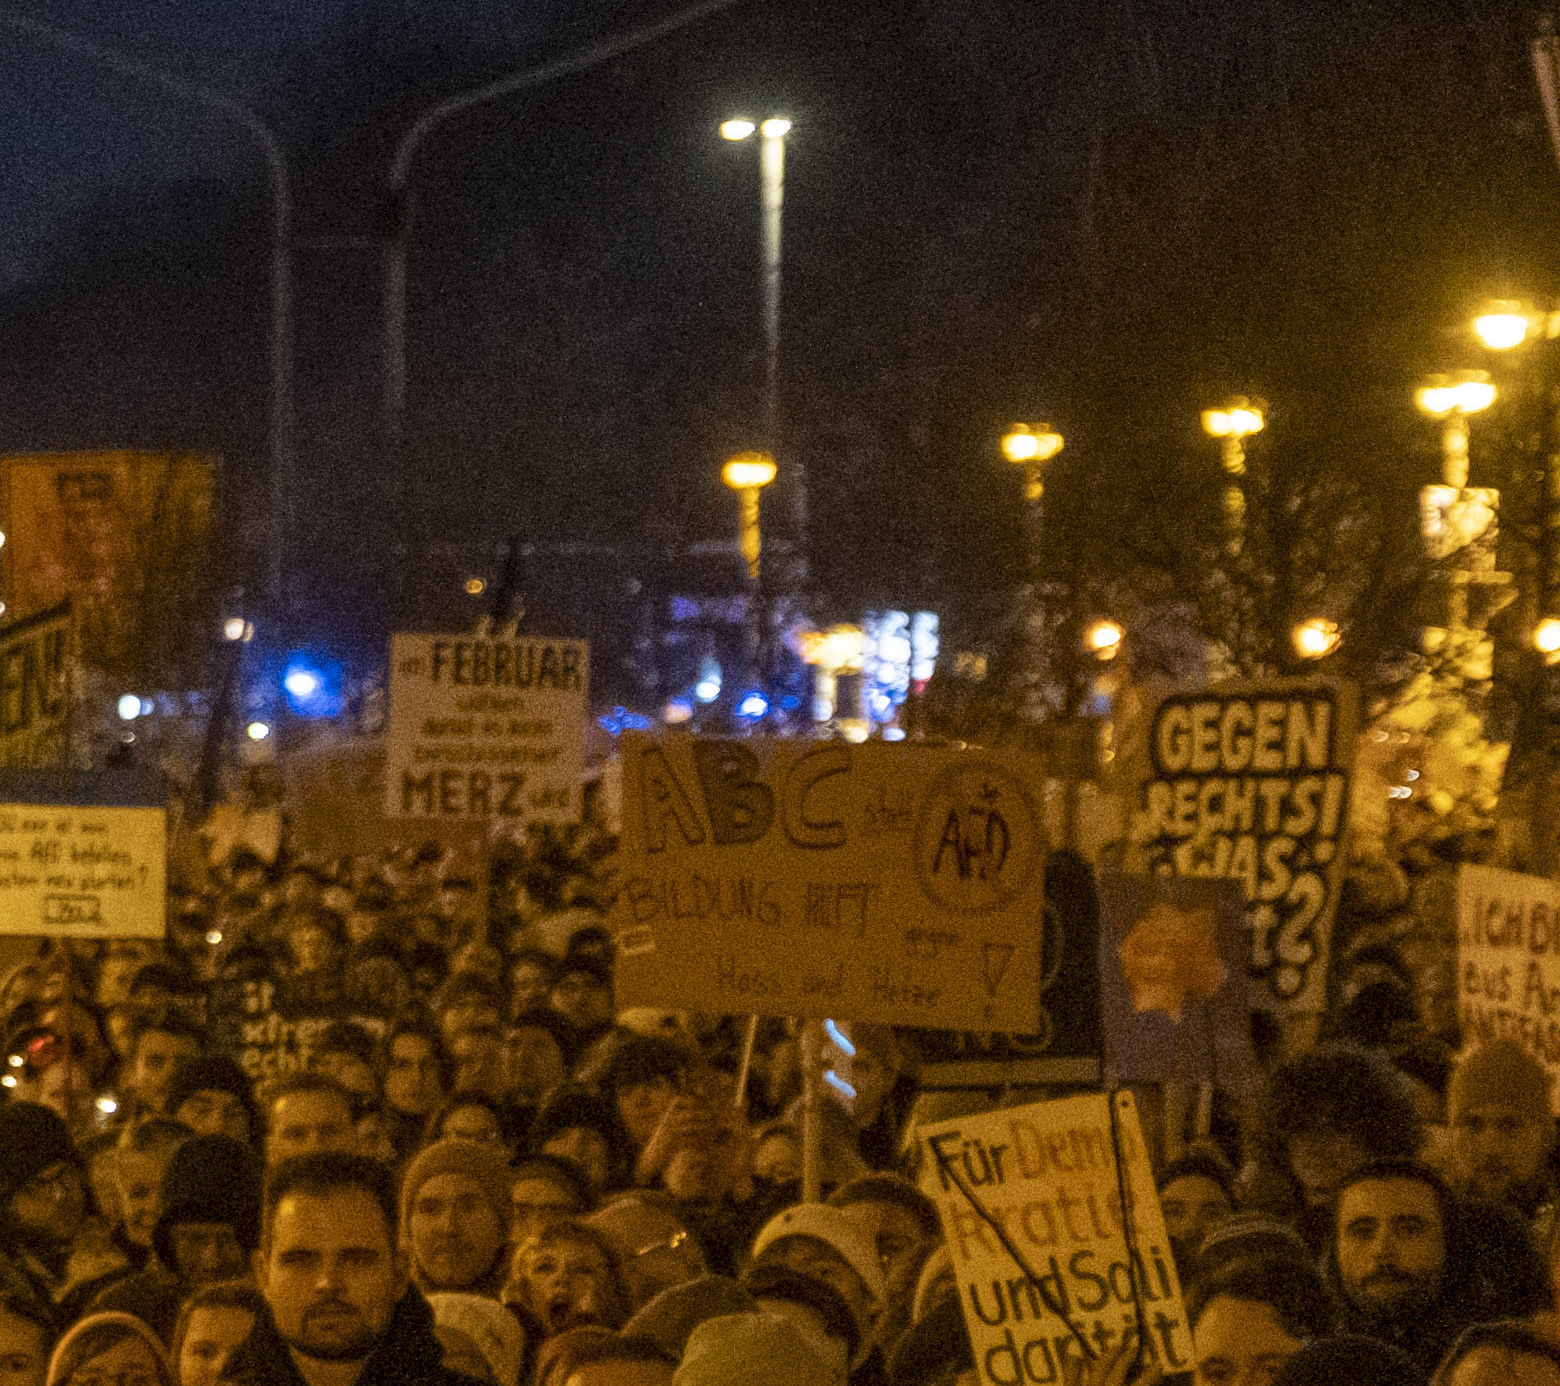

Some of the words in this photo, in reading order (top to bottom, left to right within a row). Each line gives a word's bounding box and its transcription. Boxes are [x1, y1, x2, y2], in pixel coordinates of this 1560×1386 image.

[432, 640, 581, 690] FEBRUAR
[1157, 699, 1331, 772] GEGEN
[400, 770, 527, 816] MERZ
[639, 739, 853, 855] ABC
[1132, 775, 1344, 862] RECHTS!
[624, 873, 782, 925] BILDUNG
[927, 1130, 1009, 1192] Für
[970, 1255, 1071, 1327] und
